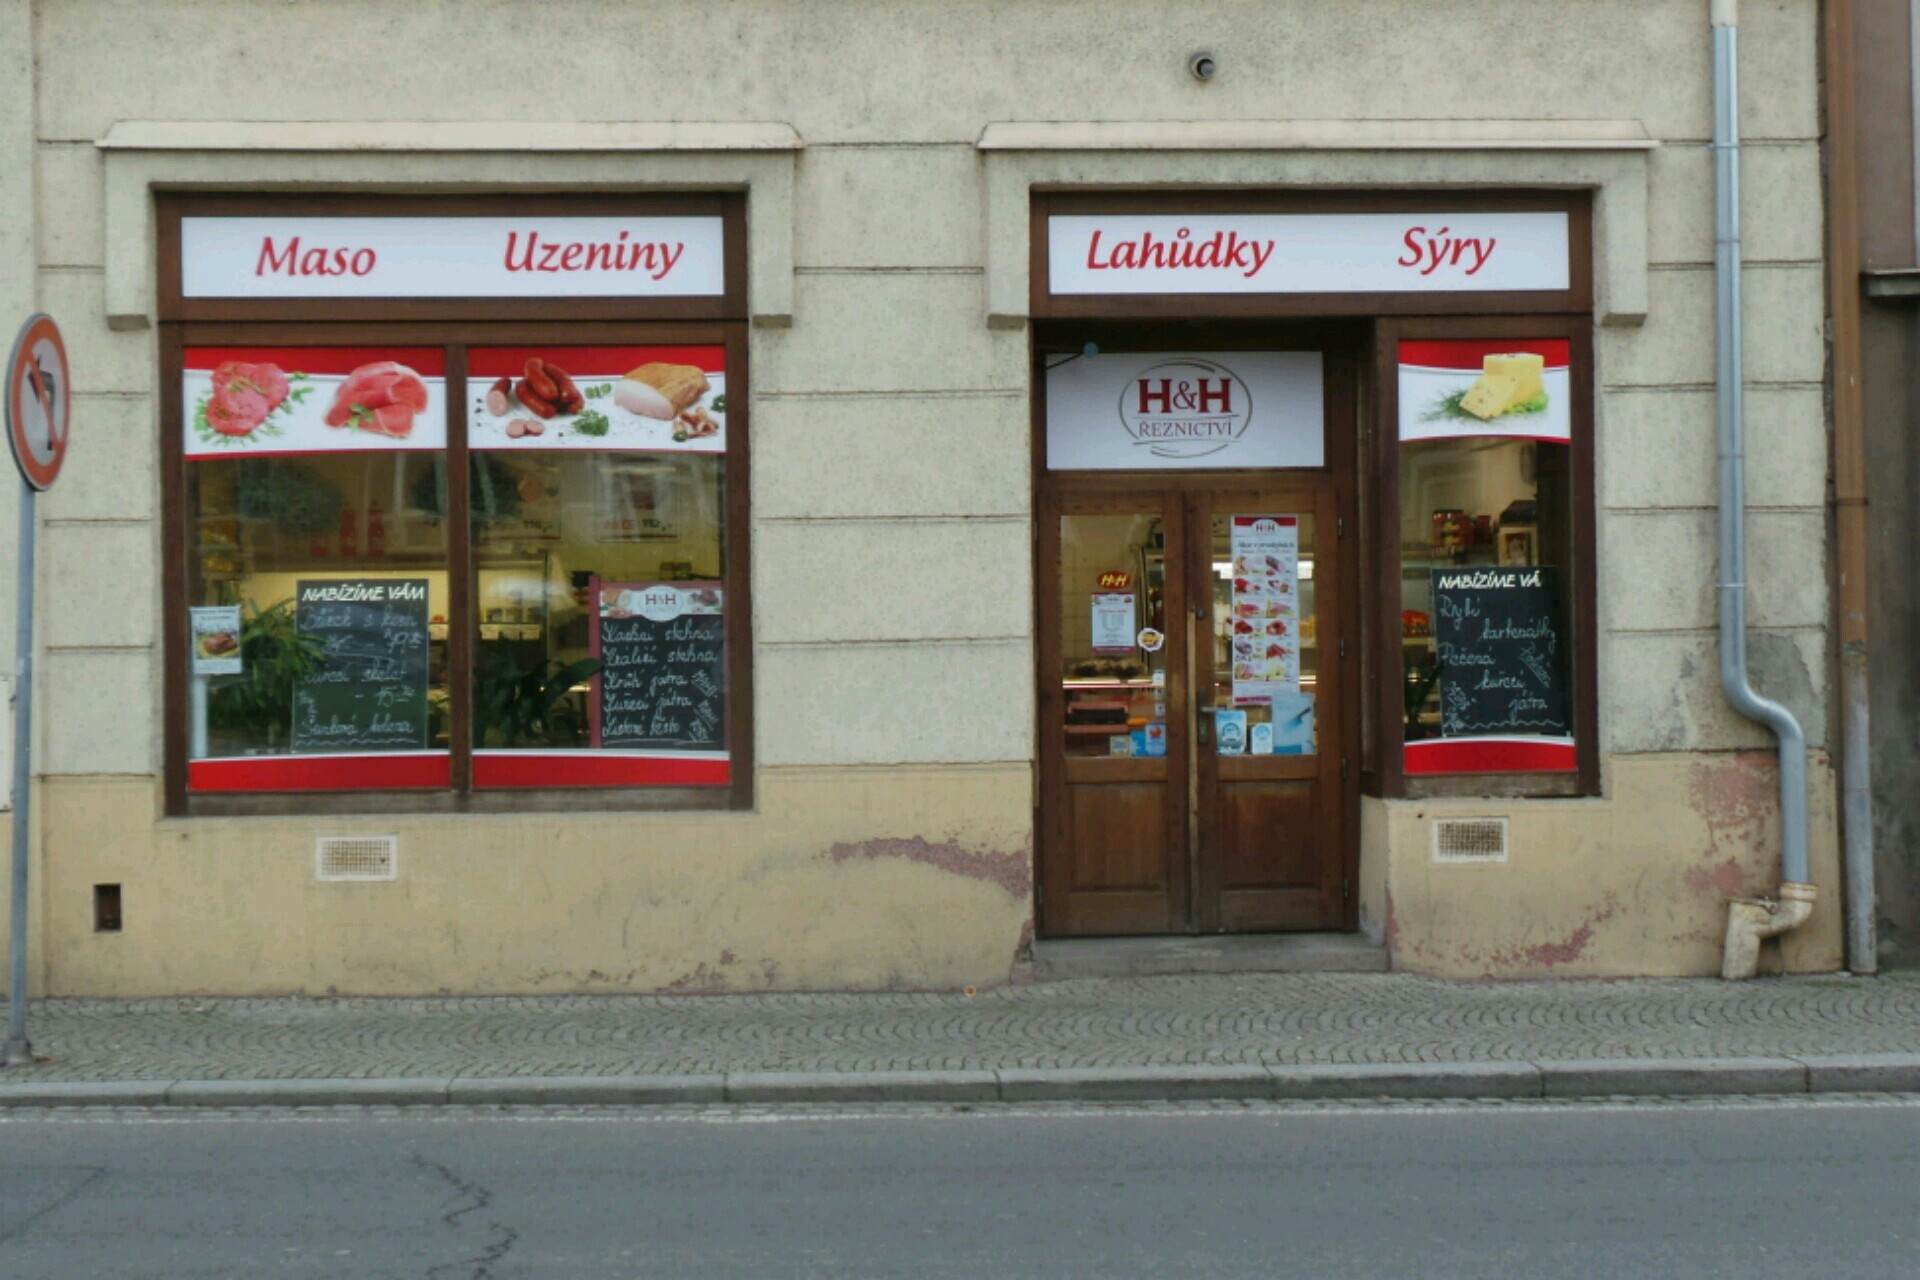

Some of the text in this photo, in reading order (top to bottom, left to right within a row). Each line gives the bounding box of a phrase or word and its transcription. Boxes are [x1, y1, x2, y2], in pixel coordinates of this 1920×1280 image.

[254, 230, 685, 281] Maso Uzeniny
[1086, 226, 1497, 279] Lahůdky Sýry
[1137, 377, 1233, 414] H&H
[1138, 416, 1233, 439] ŘEZNICTVÍ
[302, 581, 425, 603] NABÍZÍME VÁM
[1438, 569, 1542, 590] NABÍZÍME VÁ
